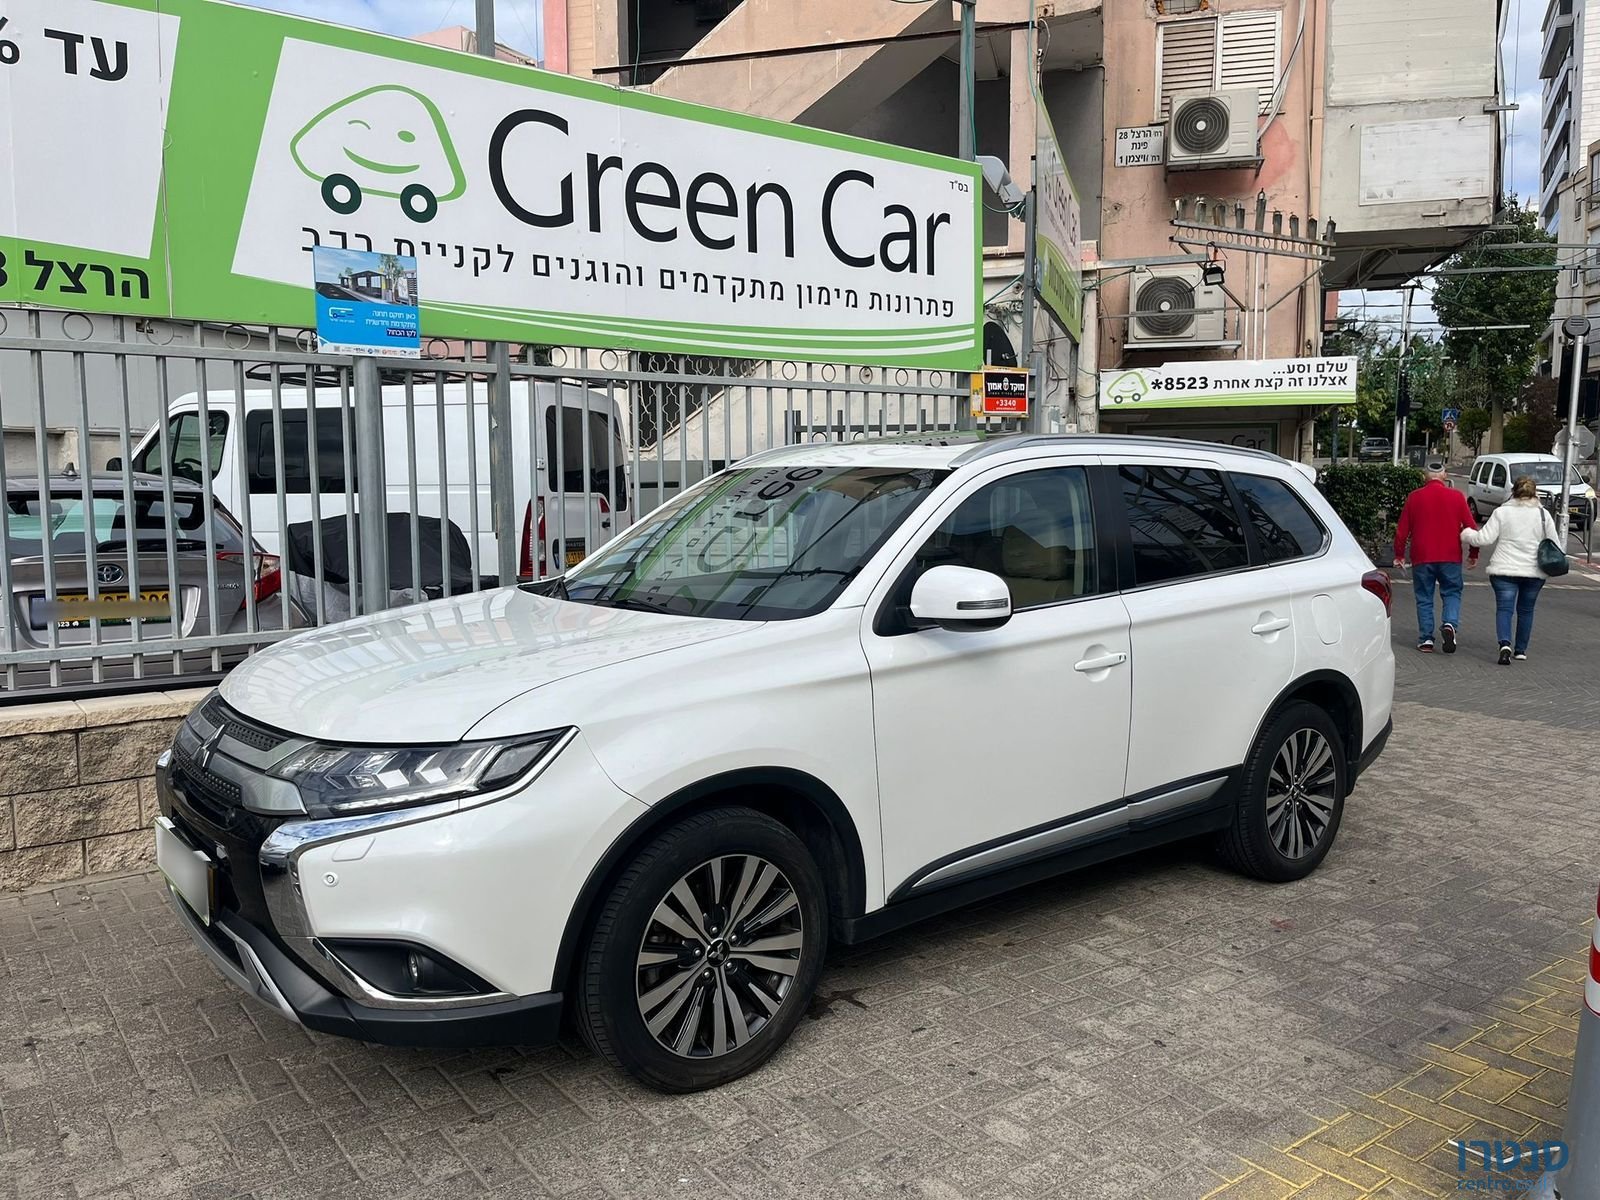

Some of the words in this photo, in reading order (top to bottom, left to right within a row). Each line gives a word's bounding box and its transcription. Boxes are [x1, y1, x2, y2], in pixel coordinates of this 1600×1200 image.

[44, 28, 128, 81] עד
[1118, 131, 1128, 140] 28
[1130, 129, 1152, 139] הרצל
[1131, 141, 1148, 150] פינת
[1119, 155, 1123, 164] 1
[488, 109, 794, 258] Green
[821, 170, 951, 276] Car
[393, 237, 514, 277] לקניית
[25, 249, 150, 299] הרצל
[533, 254, 643, 287] והוגנים
[660, 268, 784, 302] מתקדמים
[797, 284, 858, 309] מימון
[869, 291, 954, 318] פתרונות
[1272, 364, 1310, 374] וסע...
[1316, 361, 1348, 373] שלם
[1213, 379, 1250, 389] אחרת
[1254, 378, 1283, 390] קצת
[1288, 377, 1303, 387] זה
[1308, 374, 1347, 386] אצלנו
